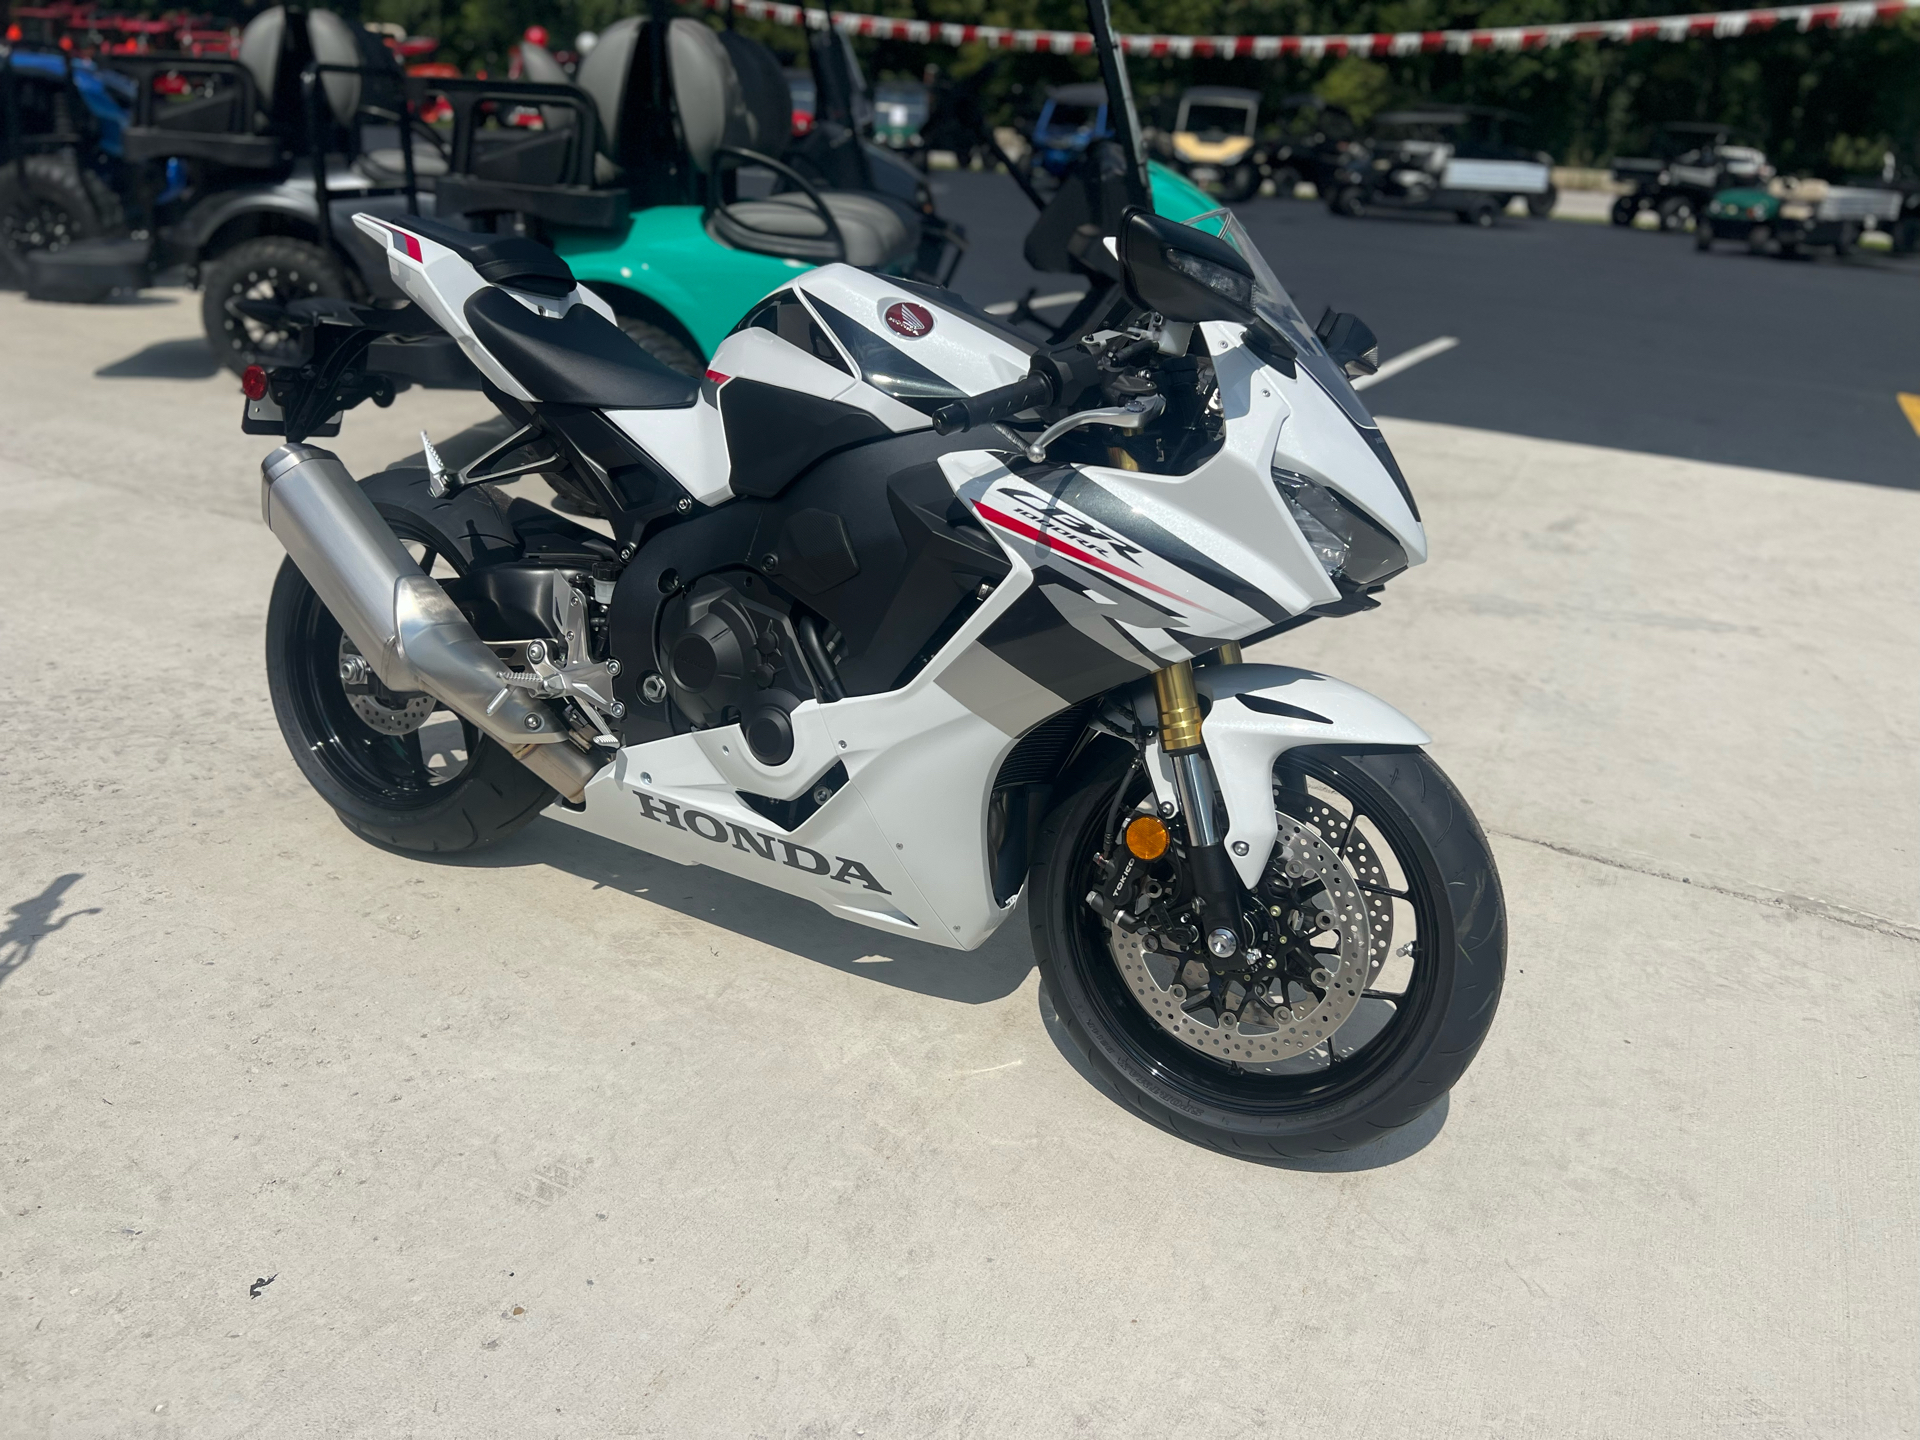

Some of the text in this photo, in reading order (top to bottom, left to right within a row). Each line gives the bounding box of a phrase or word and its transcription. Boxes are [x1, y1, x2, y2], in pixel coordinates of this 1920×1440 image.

[997, 487, 1144, 569] CBR
[1013, 507, 1110, 559] 1000RR
[632, 789, 892, 896] HONDA
[1112, 858, 1135, 897] TOKICO
[1117, 1057, 1204, 1117] SPORTMAX
